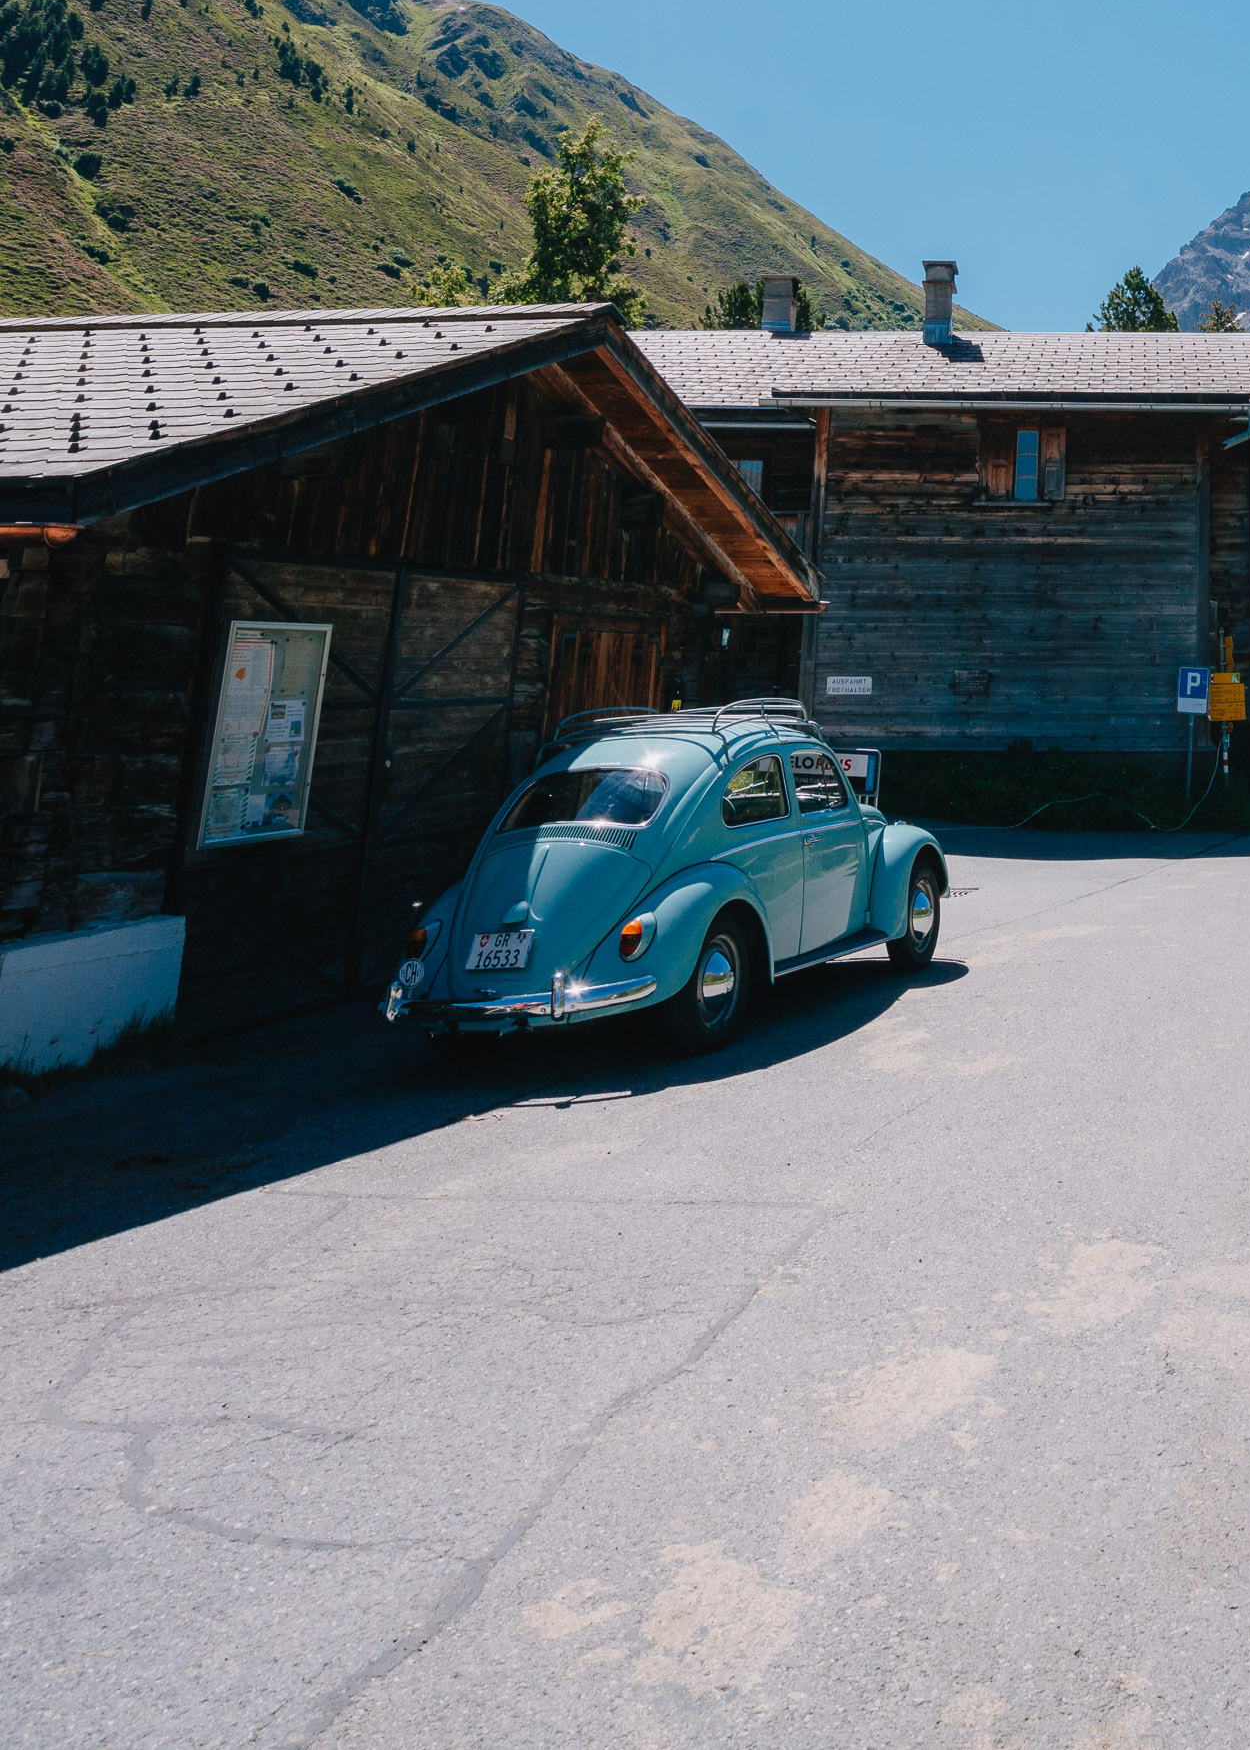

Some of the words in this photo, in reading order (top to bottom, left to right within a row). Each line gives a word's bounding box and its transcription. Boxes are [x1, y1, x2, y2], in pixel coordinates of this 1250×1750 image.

[1187, 672, 1200, 695] P
[495, 934, 511, 947] GR
[475, 949, 520, 968] 16533
[405, 961, 418, 983] CH
